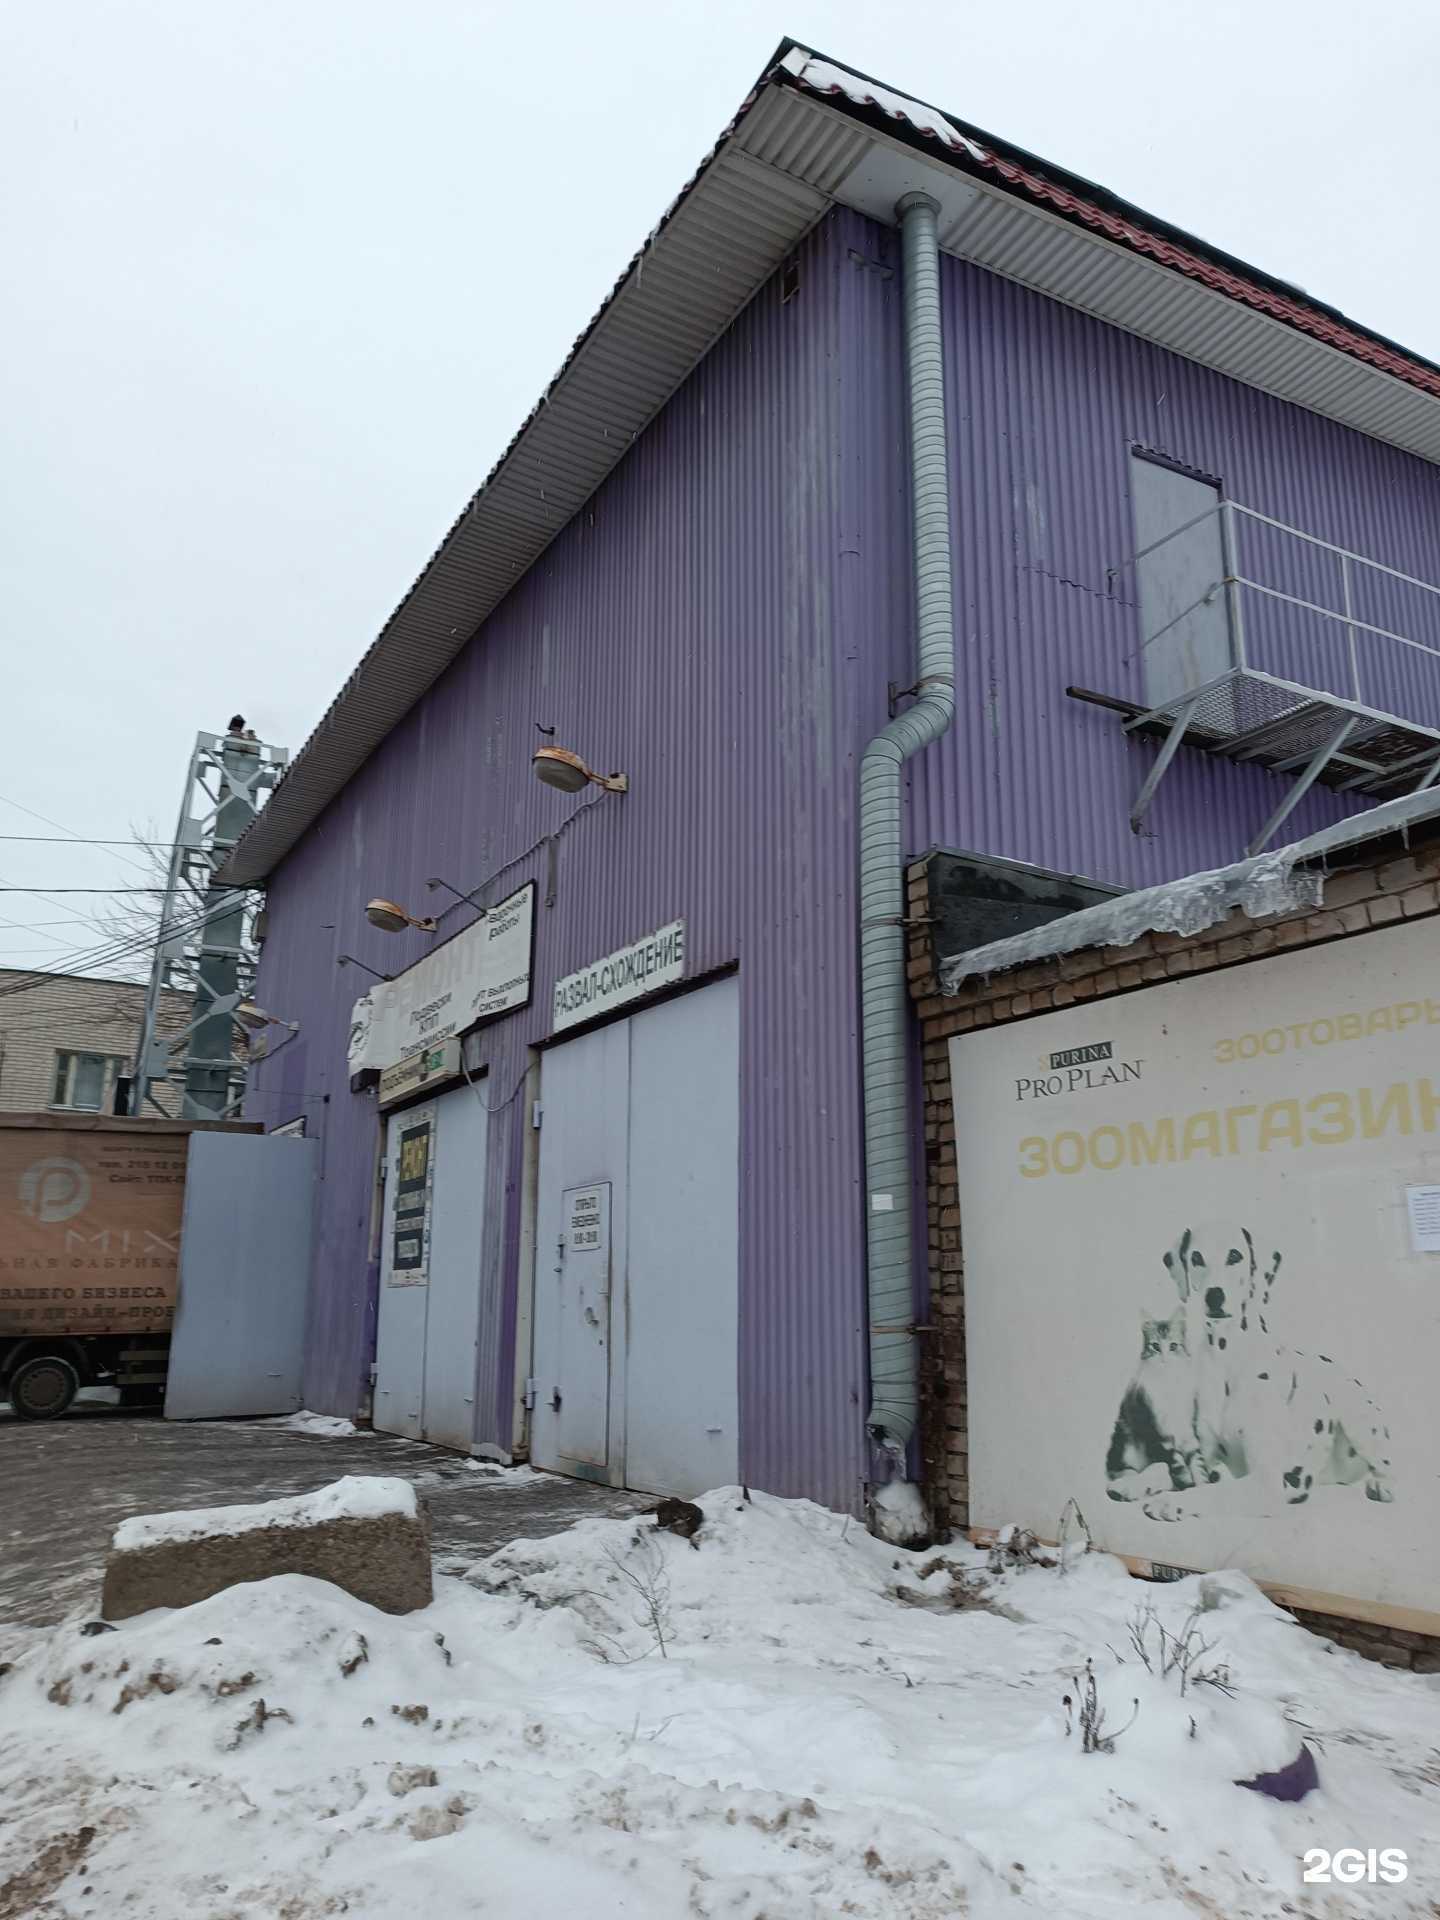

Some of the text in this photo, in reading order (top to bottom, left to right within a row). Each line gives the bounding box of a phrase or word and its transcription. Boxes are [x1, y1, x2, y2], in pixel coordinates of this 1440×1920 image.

[554, 930, 683, 1018] РАЗВАЛ-СХОЖДЕНИЕ
[1052, 1044, 1112, 1068] PURINA
[82, 1286, 167, 1299] БИЗНЕСА
